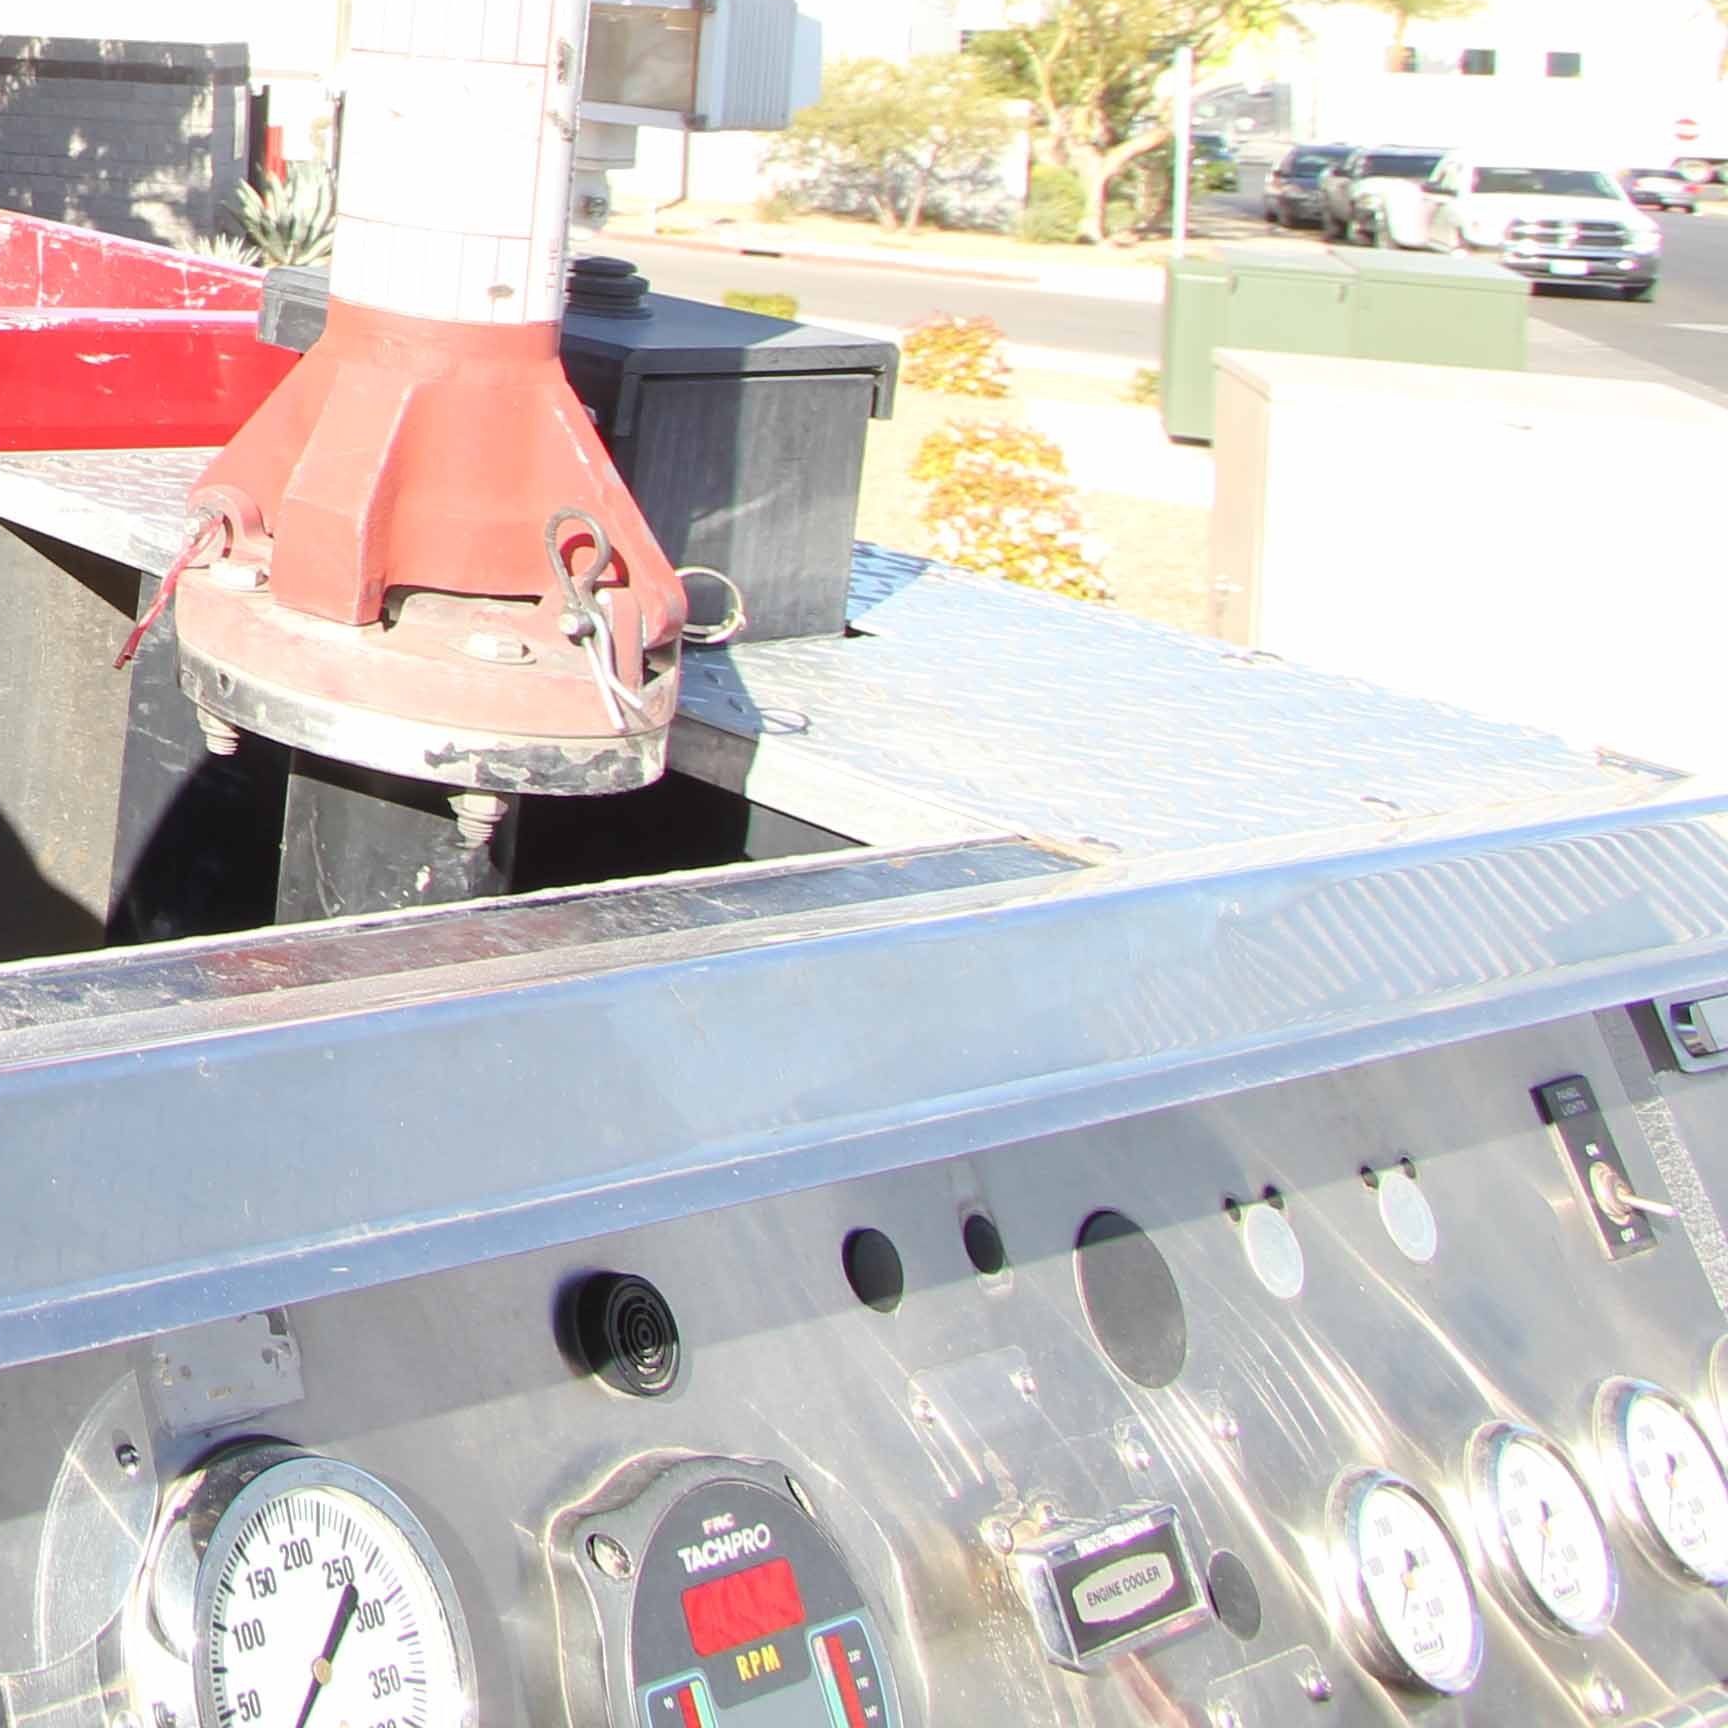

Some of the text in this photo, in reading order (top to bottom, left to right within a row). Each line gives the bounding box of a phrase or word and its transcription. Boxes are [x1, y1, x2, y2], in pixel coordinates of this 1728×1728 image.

[279, 1537, 314, 1572] 200
[677, 1522, 772, 1573] TACHPRO
[245, 1566, 278, 1601] 150
[322, 1555, 355, 1590] 250
[1085, 1564, 1162, 1608] ENGINE COOLER
[354, 1598, 386, 1633] 300
[231, 1618, 266, 1654] 100
[735, 1644, 784, 1681] RPM
[368, 1664, 401, 1699] 350
[236, 1689, 262, 1722] 50
